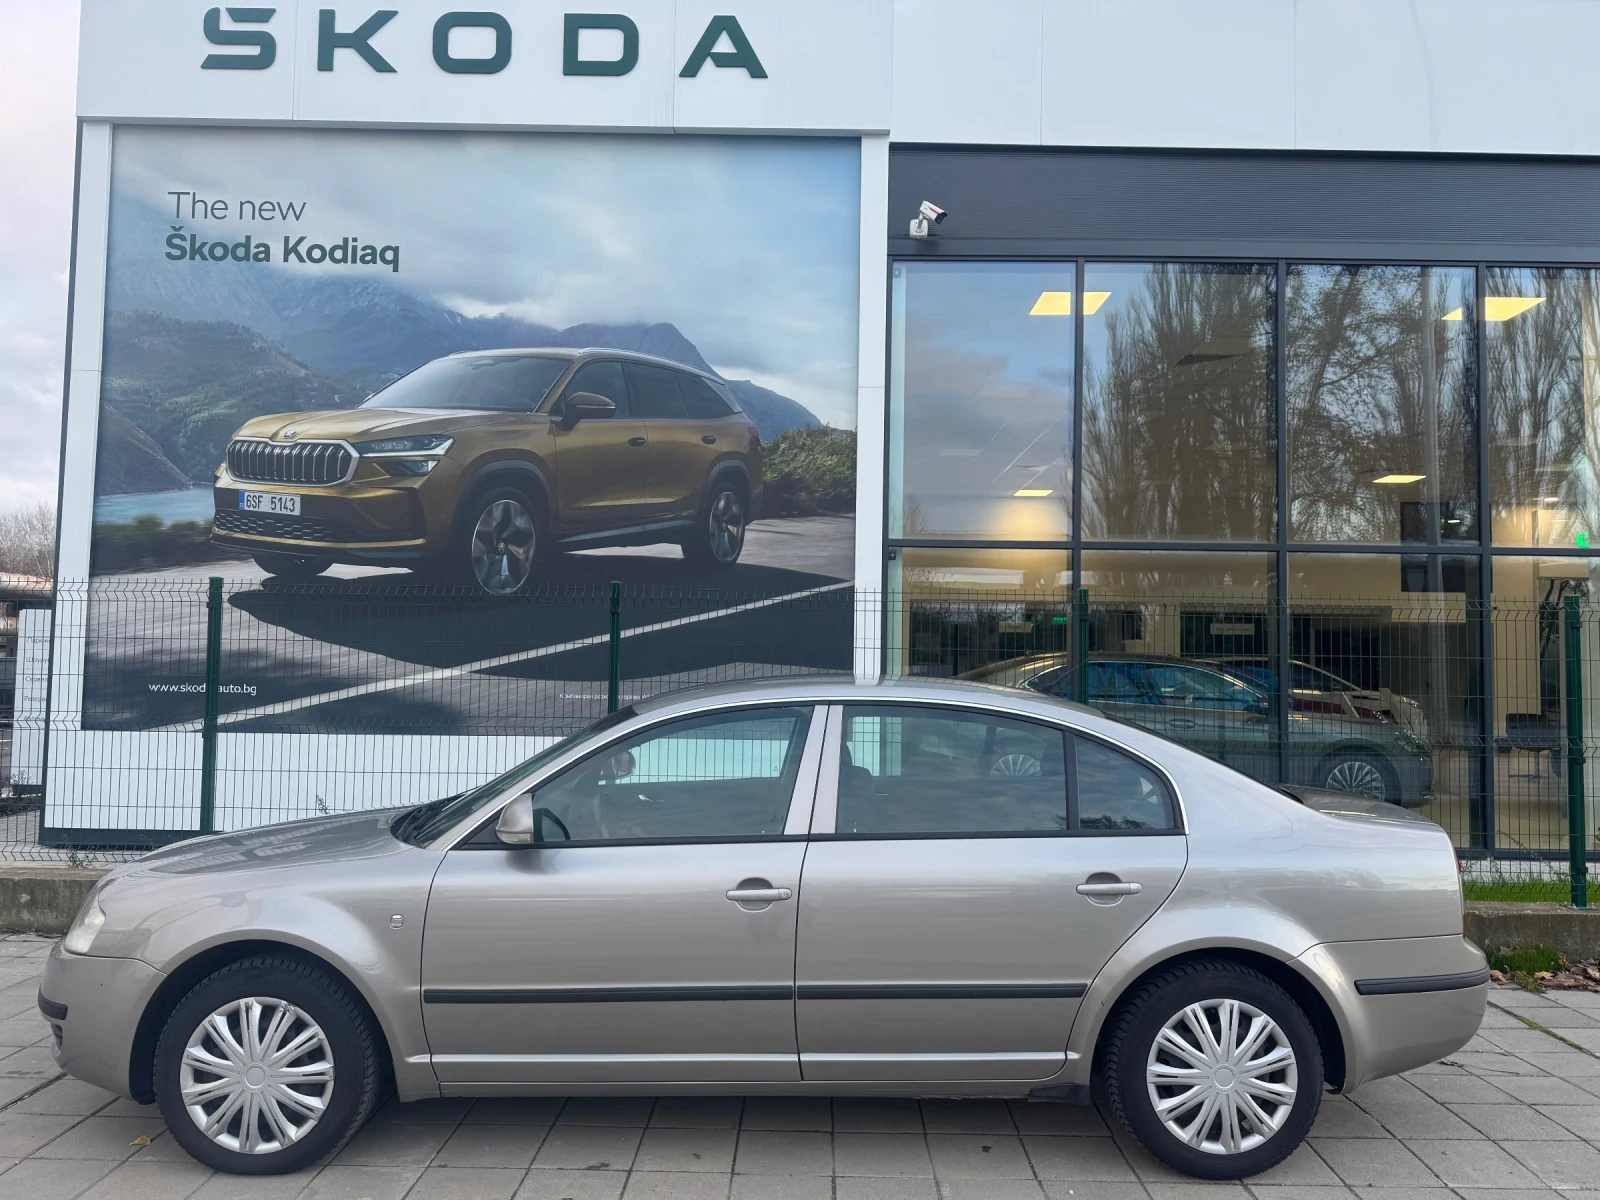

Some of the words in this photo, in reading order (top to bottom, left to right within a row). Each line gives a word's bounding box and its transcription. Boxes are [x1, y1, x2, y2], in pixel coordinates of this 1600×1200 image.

[168, 191, 228, 220] The
[239, 200, 306, 221] new
[165, 226, 271, 263] Škoda
[283, 236, 400, 272] Kodiaq
[246, 494, 263, 509] 6SF
[271, 496, 295, 512] 5143
